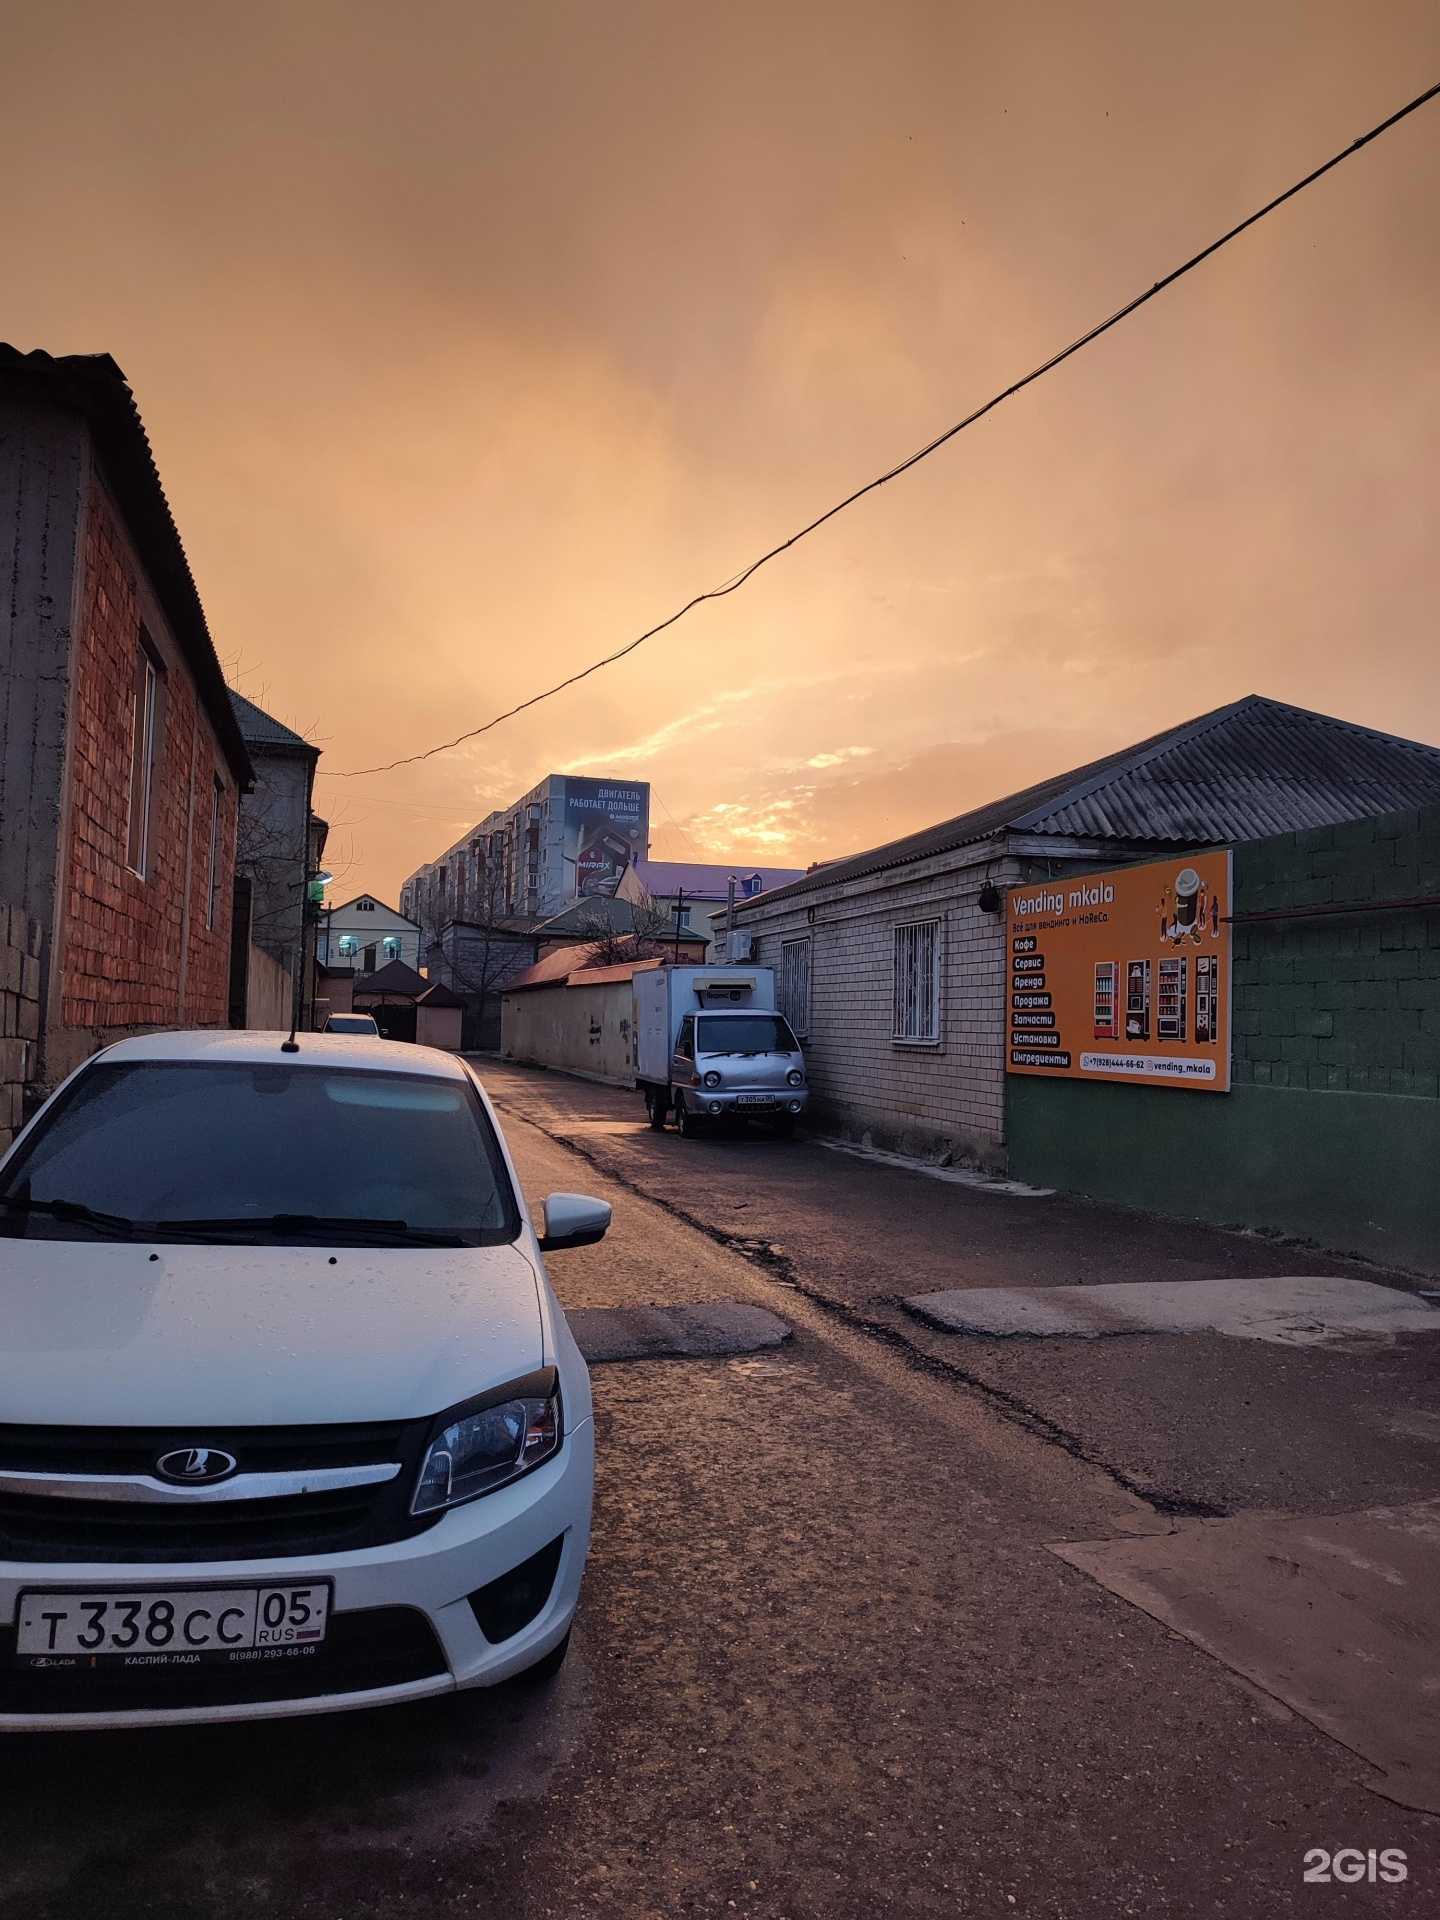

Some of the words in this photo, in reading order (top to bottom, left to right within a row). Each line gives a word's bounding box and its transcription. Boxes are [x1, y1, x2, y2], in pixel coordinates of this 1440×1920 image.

[598, 788, 641, 801] ДВИГАТЕЛЬ
[568, 798, 606, 809] РАБОТАЕТ
[607, 801, 640, 812] ДОЛЬШЕ
[1013, 890, 1064, 915] Vending
[1069, 880, 1115, 908] mkala
[1014, 938, 1034, 951] Кофе
[1015, 958, 1041, 970] Сервис
[1014, 977, 1043, 989] Аренда
[1014, 995, 1049, 1007] Продажа
[1014, 1014, 1052, 1025] Запчасти
[1013, 1033, 1057, 1044] Установка
[1013, 1052, 1068, 1065] Ингредиенты
[1153, 1061, 1211, 1074] vending_mkala
[263, 1591, 312, 1628] 05
[258, 1627, 295, 1643] RUS
[125, 1653, 201, 1666] КАСПИЙ-ЛАДА
